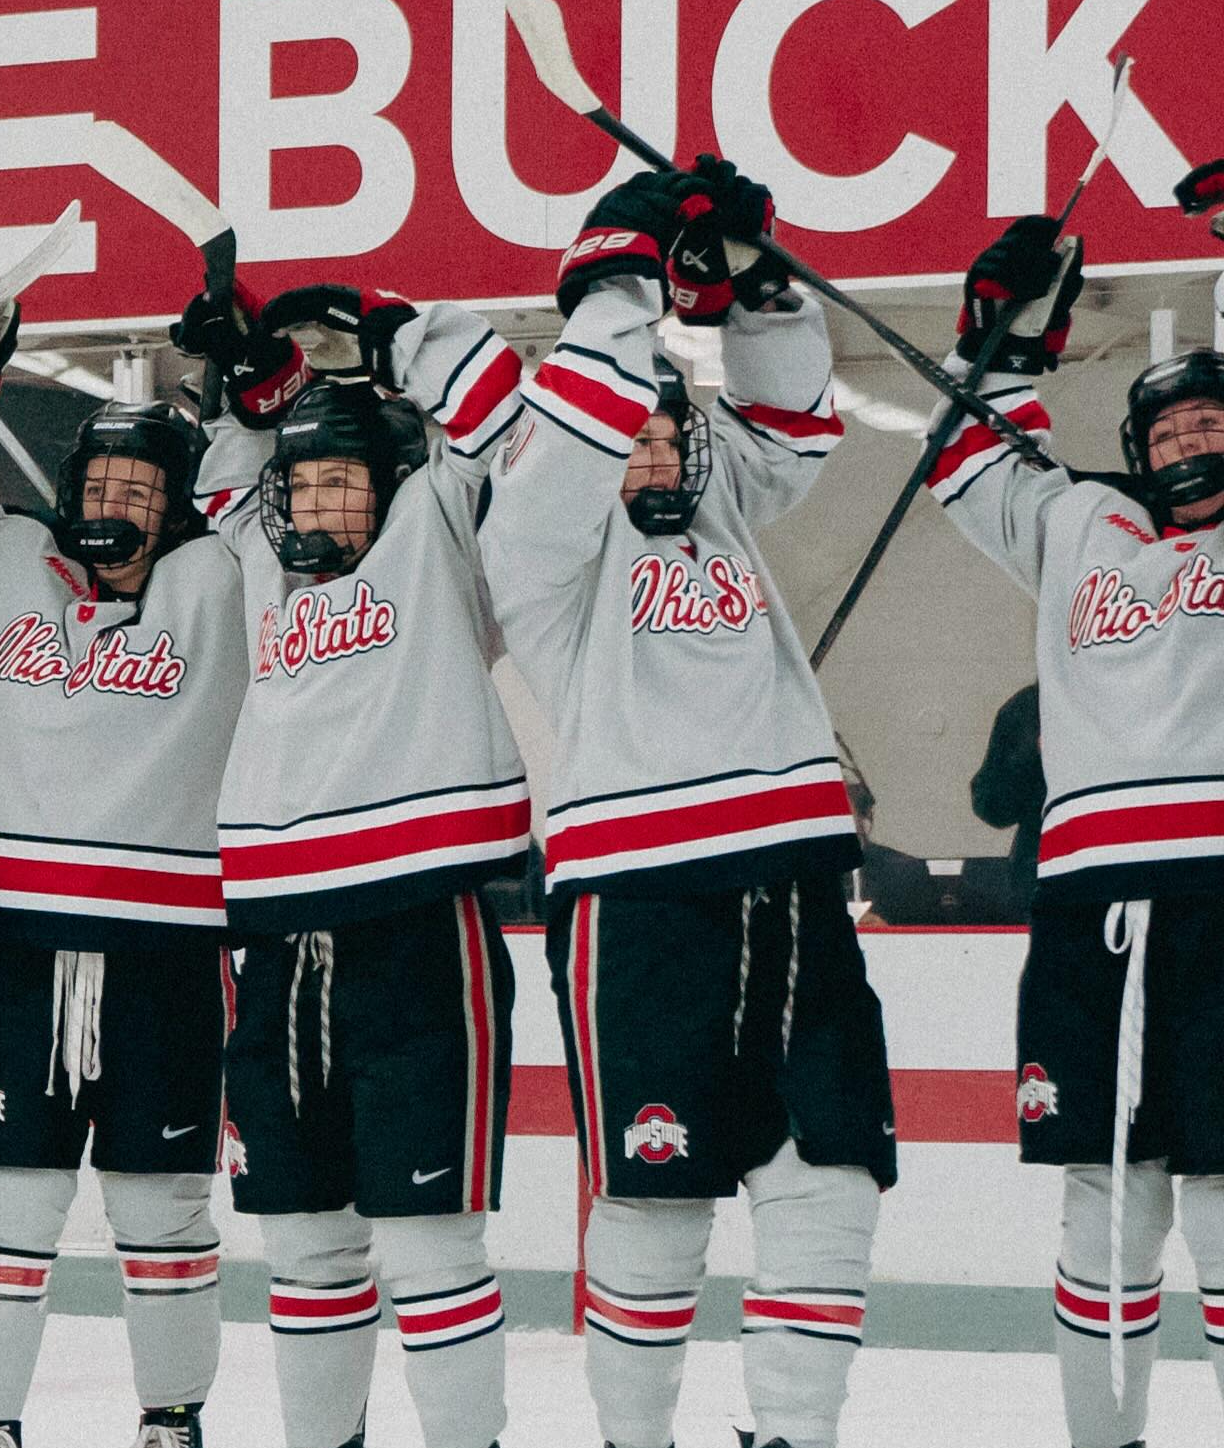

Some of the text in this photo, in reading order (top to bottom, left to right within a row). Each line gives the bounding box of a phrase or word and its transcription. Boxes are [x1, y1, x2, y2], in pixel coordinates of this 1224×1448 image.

[280, 579, 398, 678] State
[630, 553, 718, 634] Ohio
[1067, 566, 1155, 654] Ohio
[64, 626, 187, 699] State
